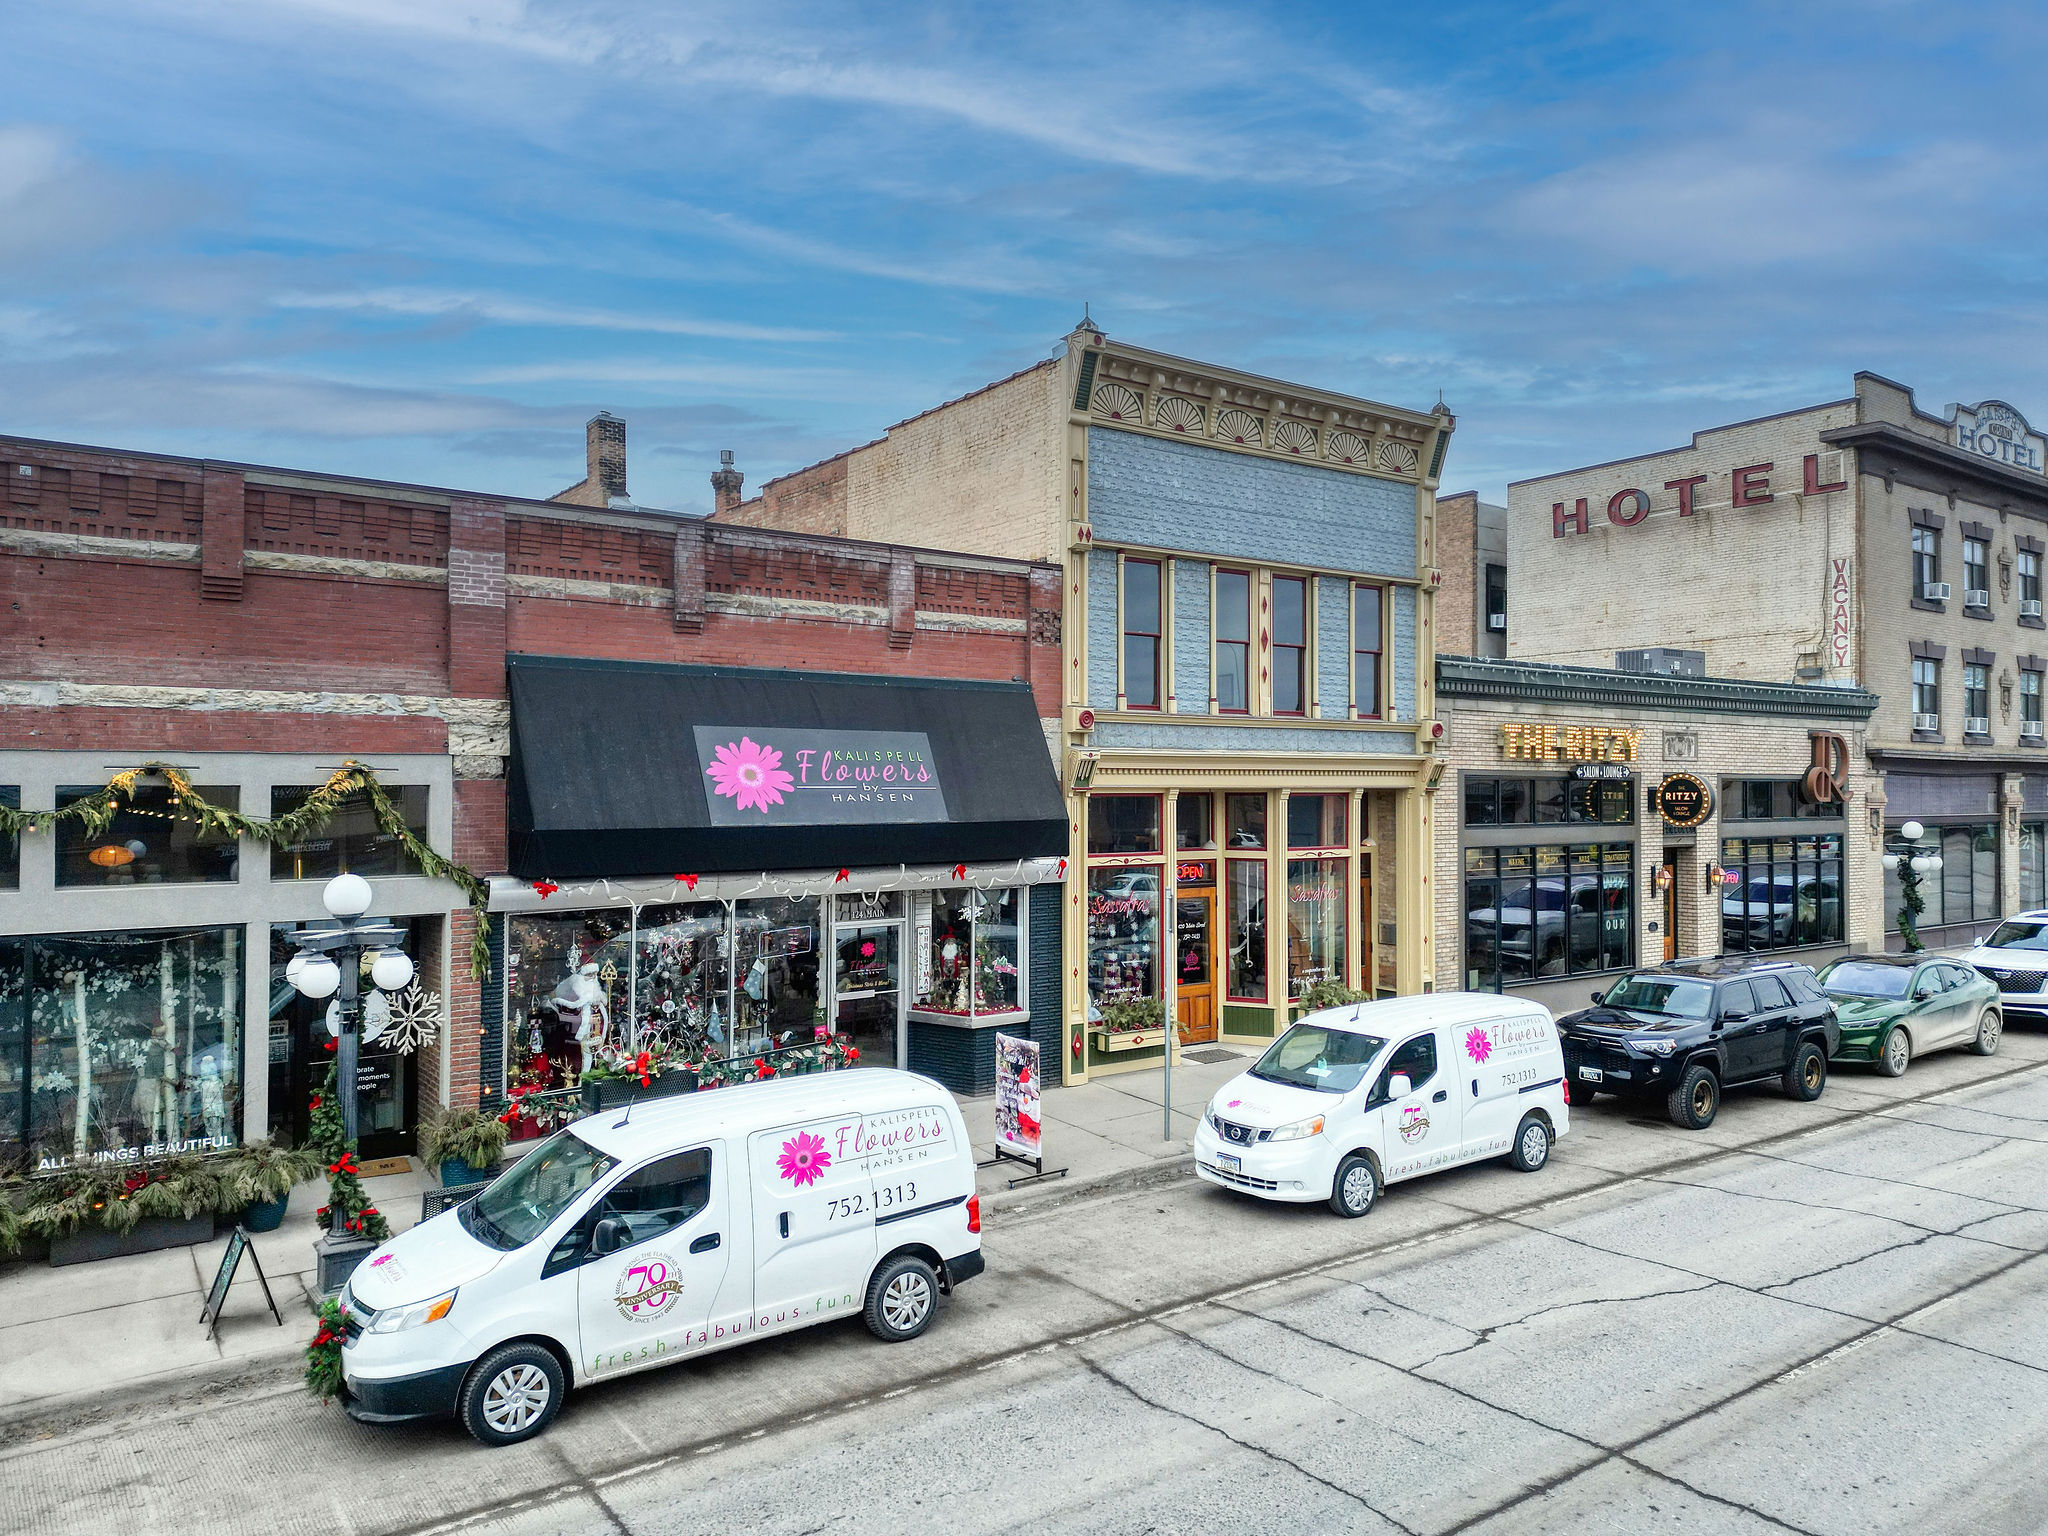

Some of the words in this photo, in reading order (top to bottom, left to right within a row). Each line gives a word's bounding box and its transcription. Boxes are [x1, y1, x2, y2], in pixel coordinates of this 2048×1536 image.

[1959, 424, 2043, 472] HOTEL
[1552, 453, 1848, 538] HOTEL
[1832, 558, 1847, 668] VACANCY
[1504, 723, 1558, 760] THE
[1566, 726, 1645, 762] RITZY
[833, 750, 923, 762] KALISPELL
[796, 750, 932, 784] Flowers
[1583, 766, 1600, 778] SALON
[1603, 766, 1624, 778] LOUNGE
[831, 793, 914, 802] HANSEN
[862, 782, 879, 793] by
[1665, 792, 1698, 801] RITZY
[1176, 866, 1204, 879] OPEN
[1290, 881, 1339, 903] Sassafras
[866, 909, 886, 918] MAIN
[1089, 890, 1150, 918] Sassafras
[269, 1026, 284, 1036] PEN
[1491, 1024, 1545, 1047] Flowers
[357, 1066, 375, 1074] brate
[358, 1072, 391, 1082] moments
[1502, 1068, 1538, 1087] 752.1313
[357, 1082, 377, 1091] eople
[870, 1108, 938, 1129] KALISPELL
[835, 1119, 944, 1159] Flowers
[38, 1157, 68, 1171] ALL
[143, 1135, 232, 1157] BEAUTIFUL
[860, 1150, 928, 1172] HANSEN
[887, 1147, 900, 1156] by
[827, 1181, 917, 1222] 752.1313
[625, 1282, 676, 1305] ANNIVERSARY
